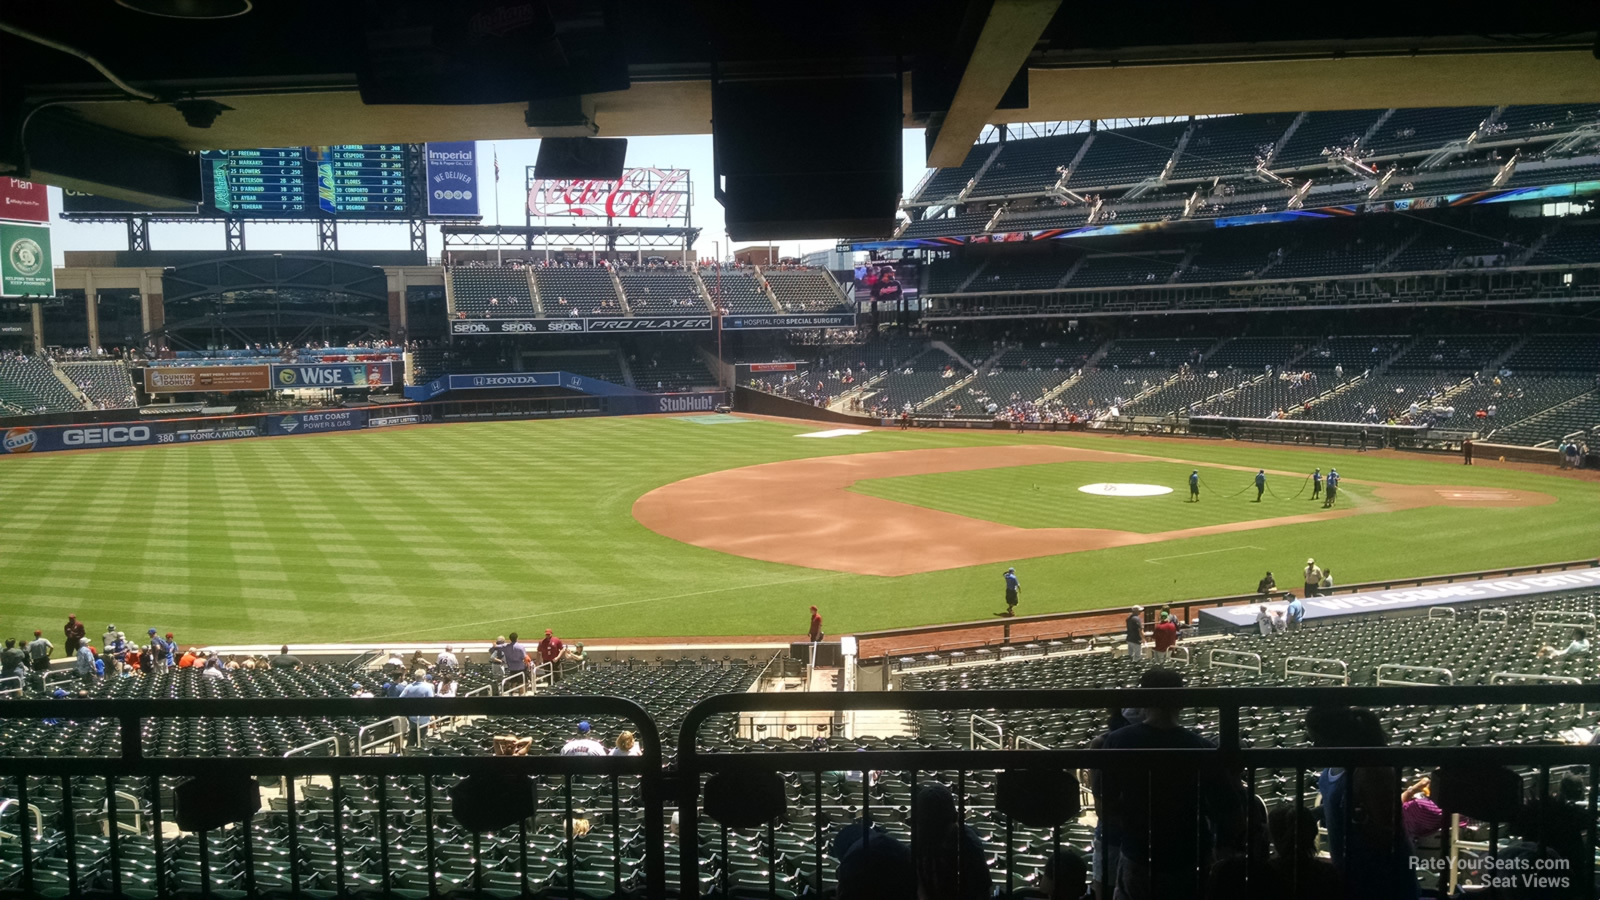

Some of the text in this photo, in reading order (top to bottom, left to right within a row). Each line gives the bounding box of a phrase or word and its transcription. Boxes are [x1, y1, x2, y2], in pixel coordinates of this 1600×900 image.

[430, 150, 472, 160] Imperial
[434, 171, 472, 184] WE DELIVER
[11, 178, 33, 190] Plan
[318, 164, 336, 207] Mets
[589, 320, 710, 329] PRO PLAYER
[486, 376, 537, 385] HONDA
[660, 396, 712, 411] StubHub!
[303, 414, 323, 422] EAST
[63, 426, 150, 445] GEICO
[158, 434, 174, 443] 380
[190, 429, 255, 440] KONICA MINOLTA
[5, 434, 34, 448] Gulf
[1307, 585, 1486, 610] WELCOME
[1473, 580, 1531, 592] TO
